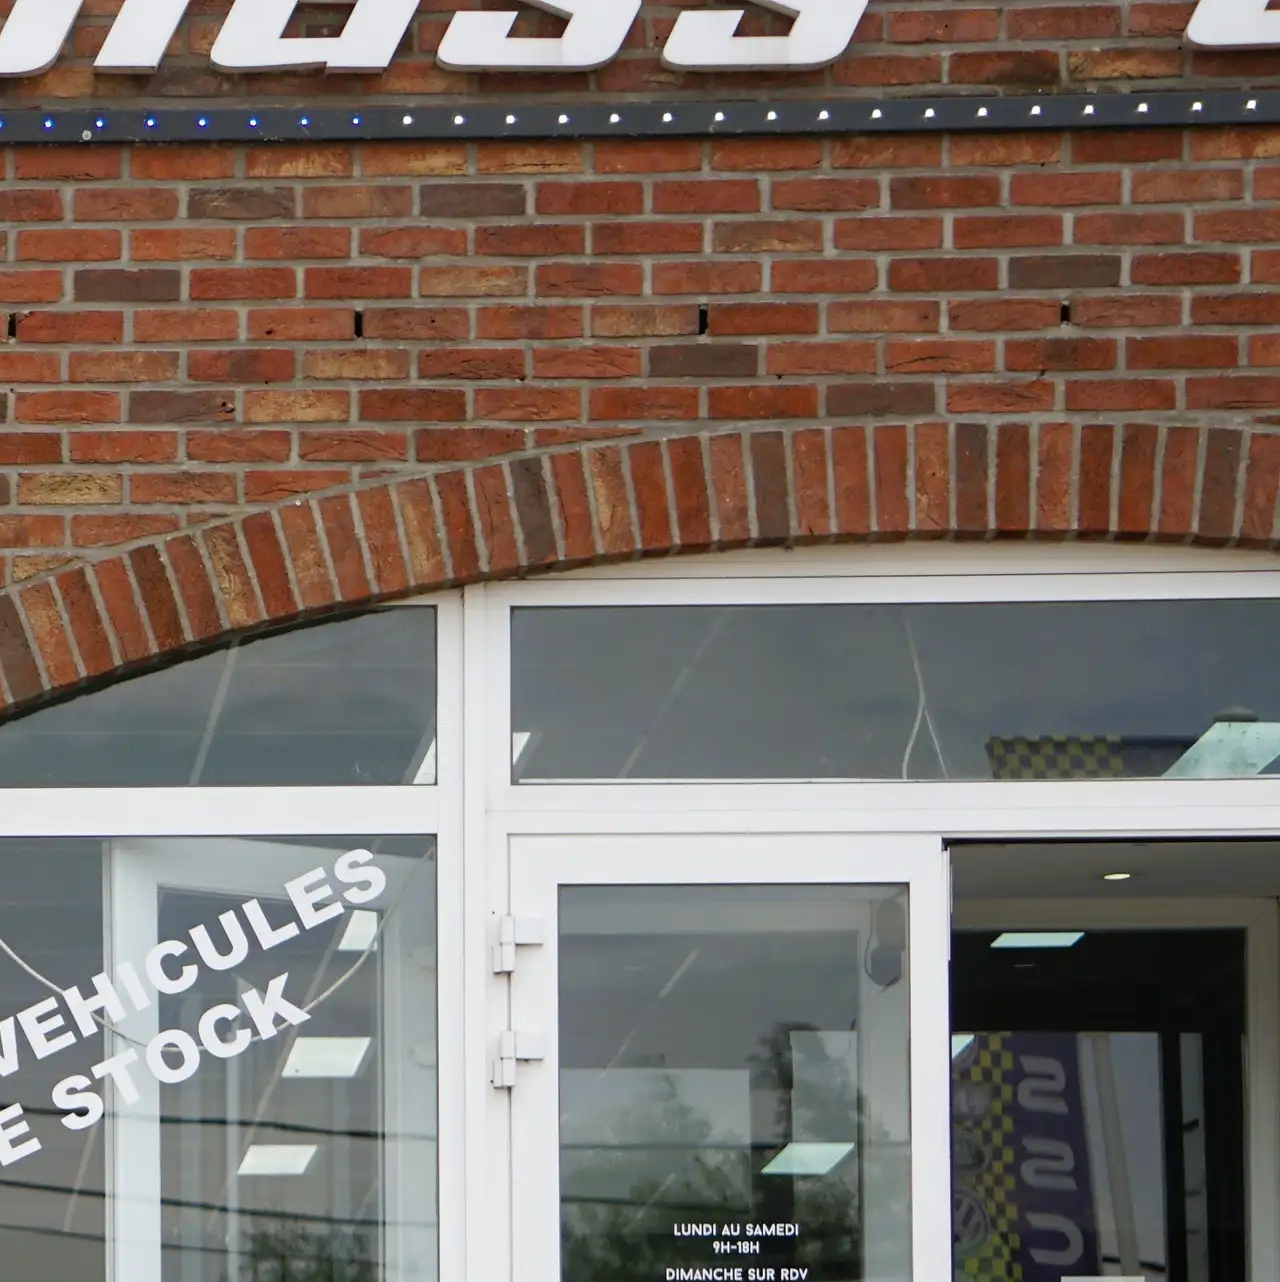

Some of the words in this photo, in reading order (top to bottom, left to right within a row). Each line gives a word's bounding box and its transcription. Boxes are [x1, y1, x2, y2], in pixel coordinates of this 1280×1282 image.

[52, 972, 311, 1130] STOCK
[673, 1224, 717, 1236] LUNDI
[721, 1224, 741, 1236] AU
[745, 1224, 799, 1236] SAMEDI
[712, 1241, 760, 1254] 9H-18H
[665, 1268, 743, 1281] DIMANCHE
[747, 1268, 775, 1281] SUR
[780, 1268, 808, 1281] RDV
